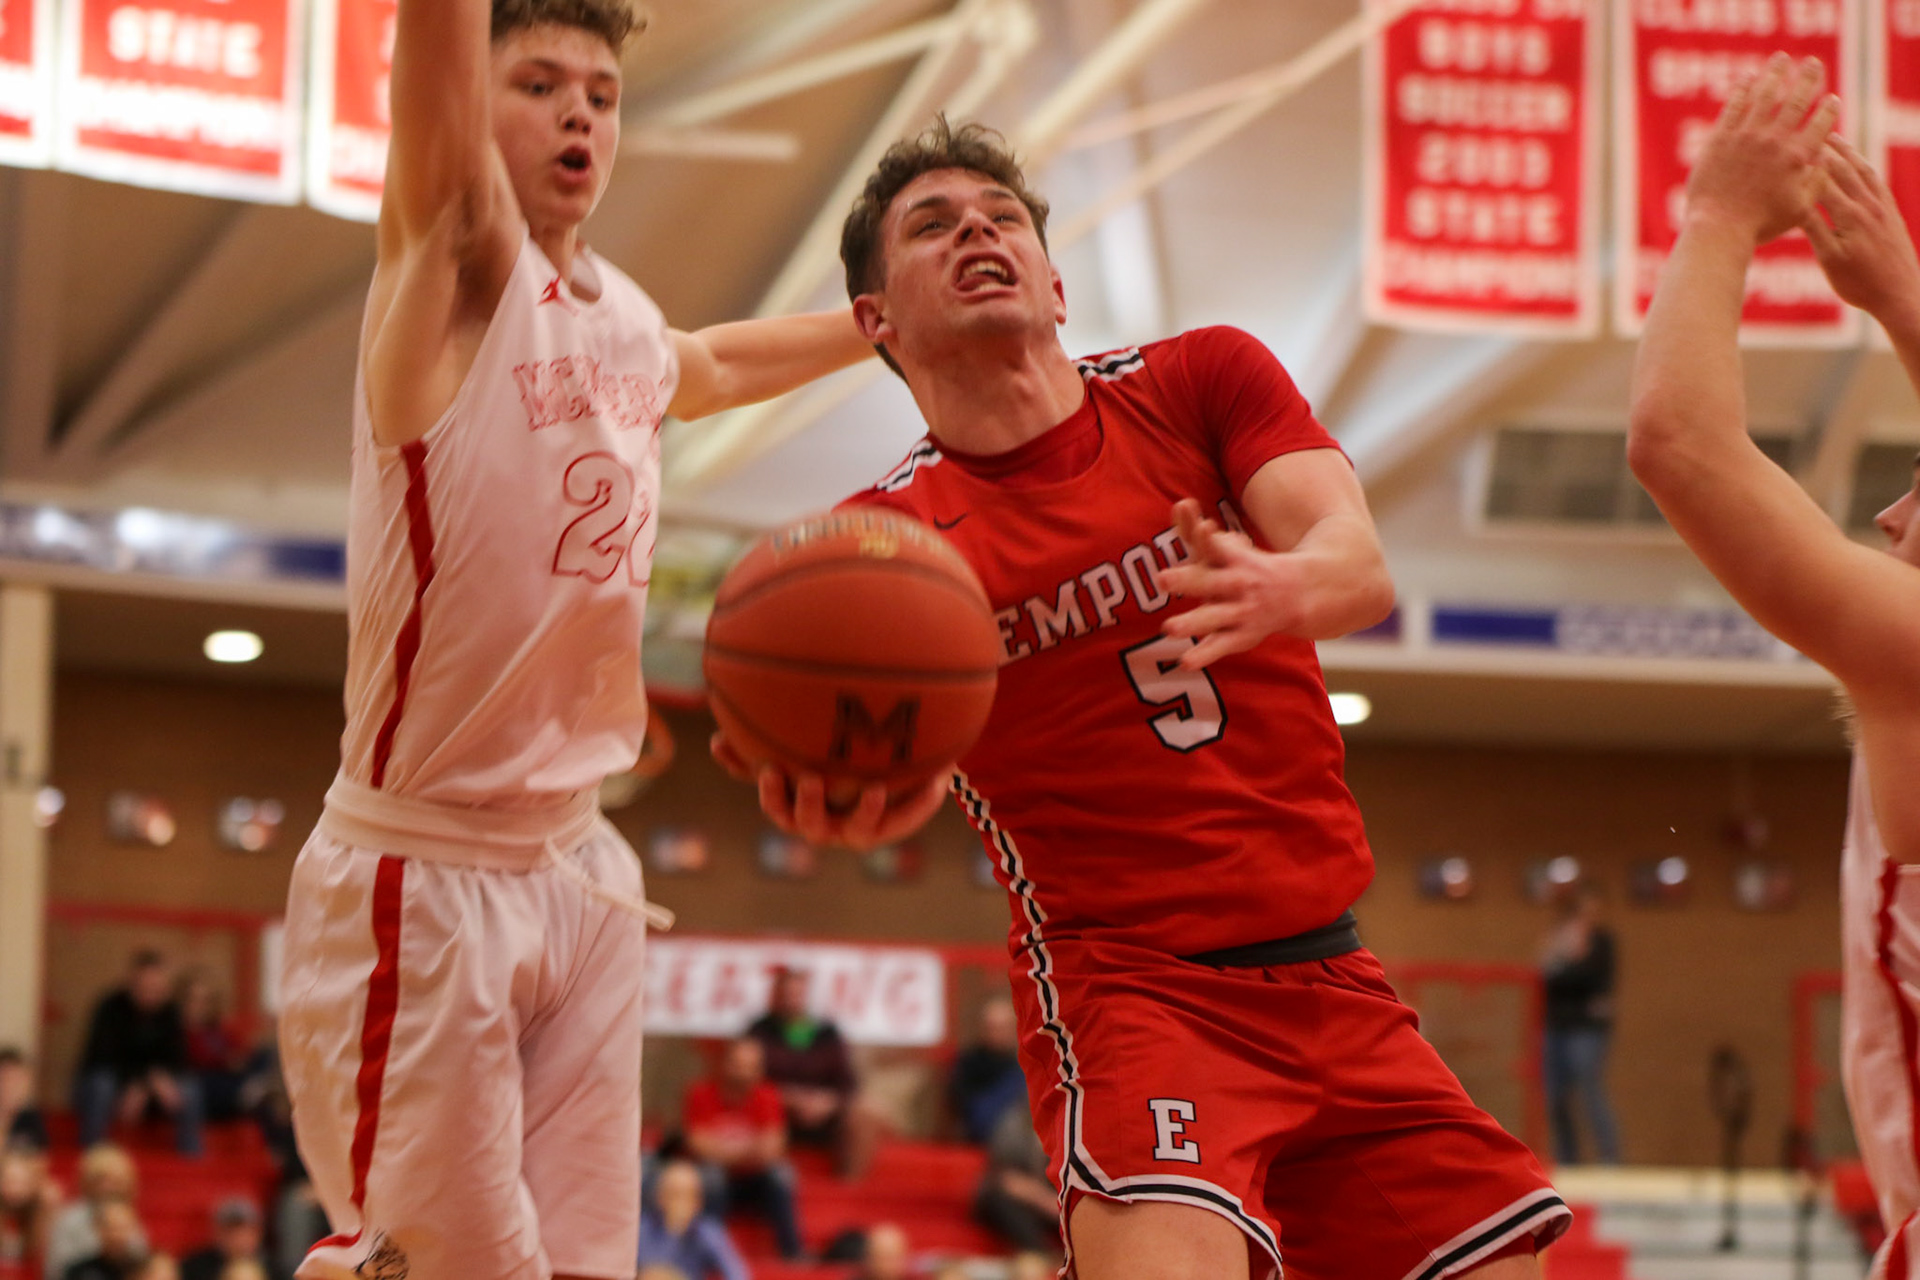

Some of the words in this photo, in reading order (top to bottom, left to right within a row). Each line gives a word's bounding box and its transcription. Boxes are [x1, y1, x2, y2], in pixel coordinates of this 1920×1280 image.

[1406, 187, 1562, 247] STATE
[993, 498, 1247, 668] EMPO
[827, 692, 921, 762] M
[1119, 634, 1228, 754] 5
[1147, 1098, 1201, 1165] E
